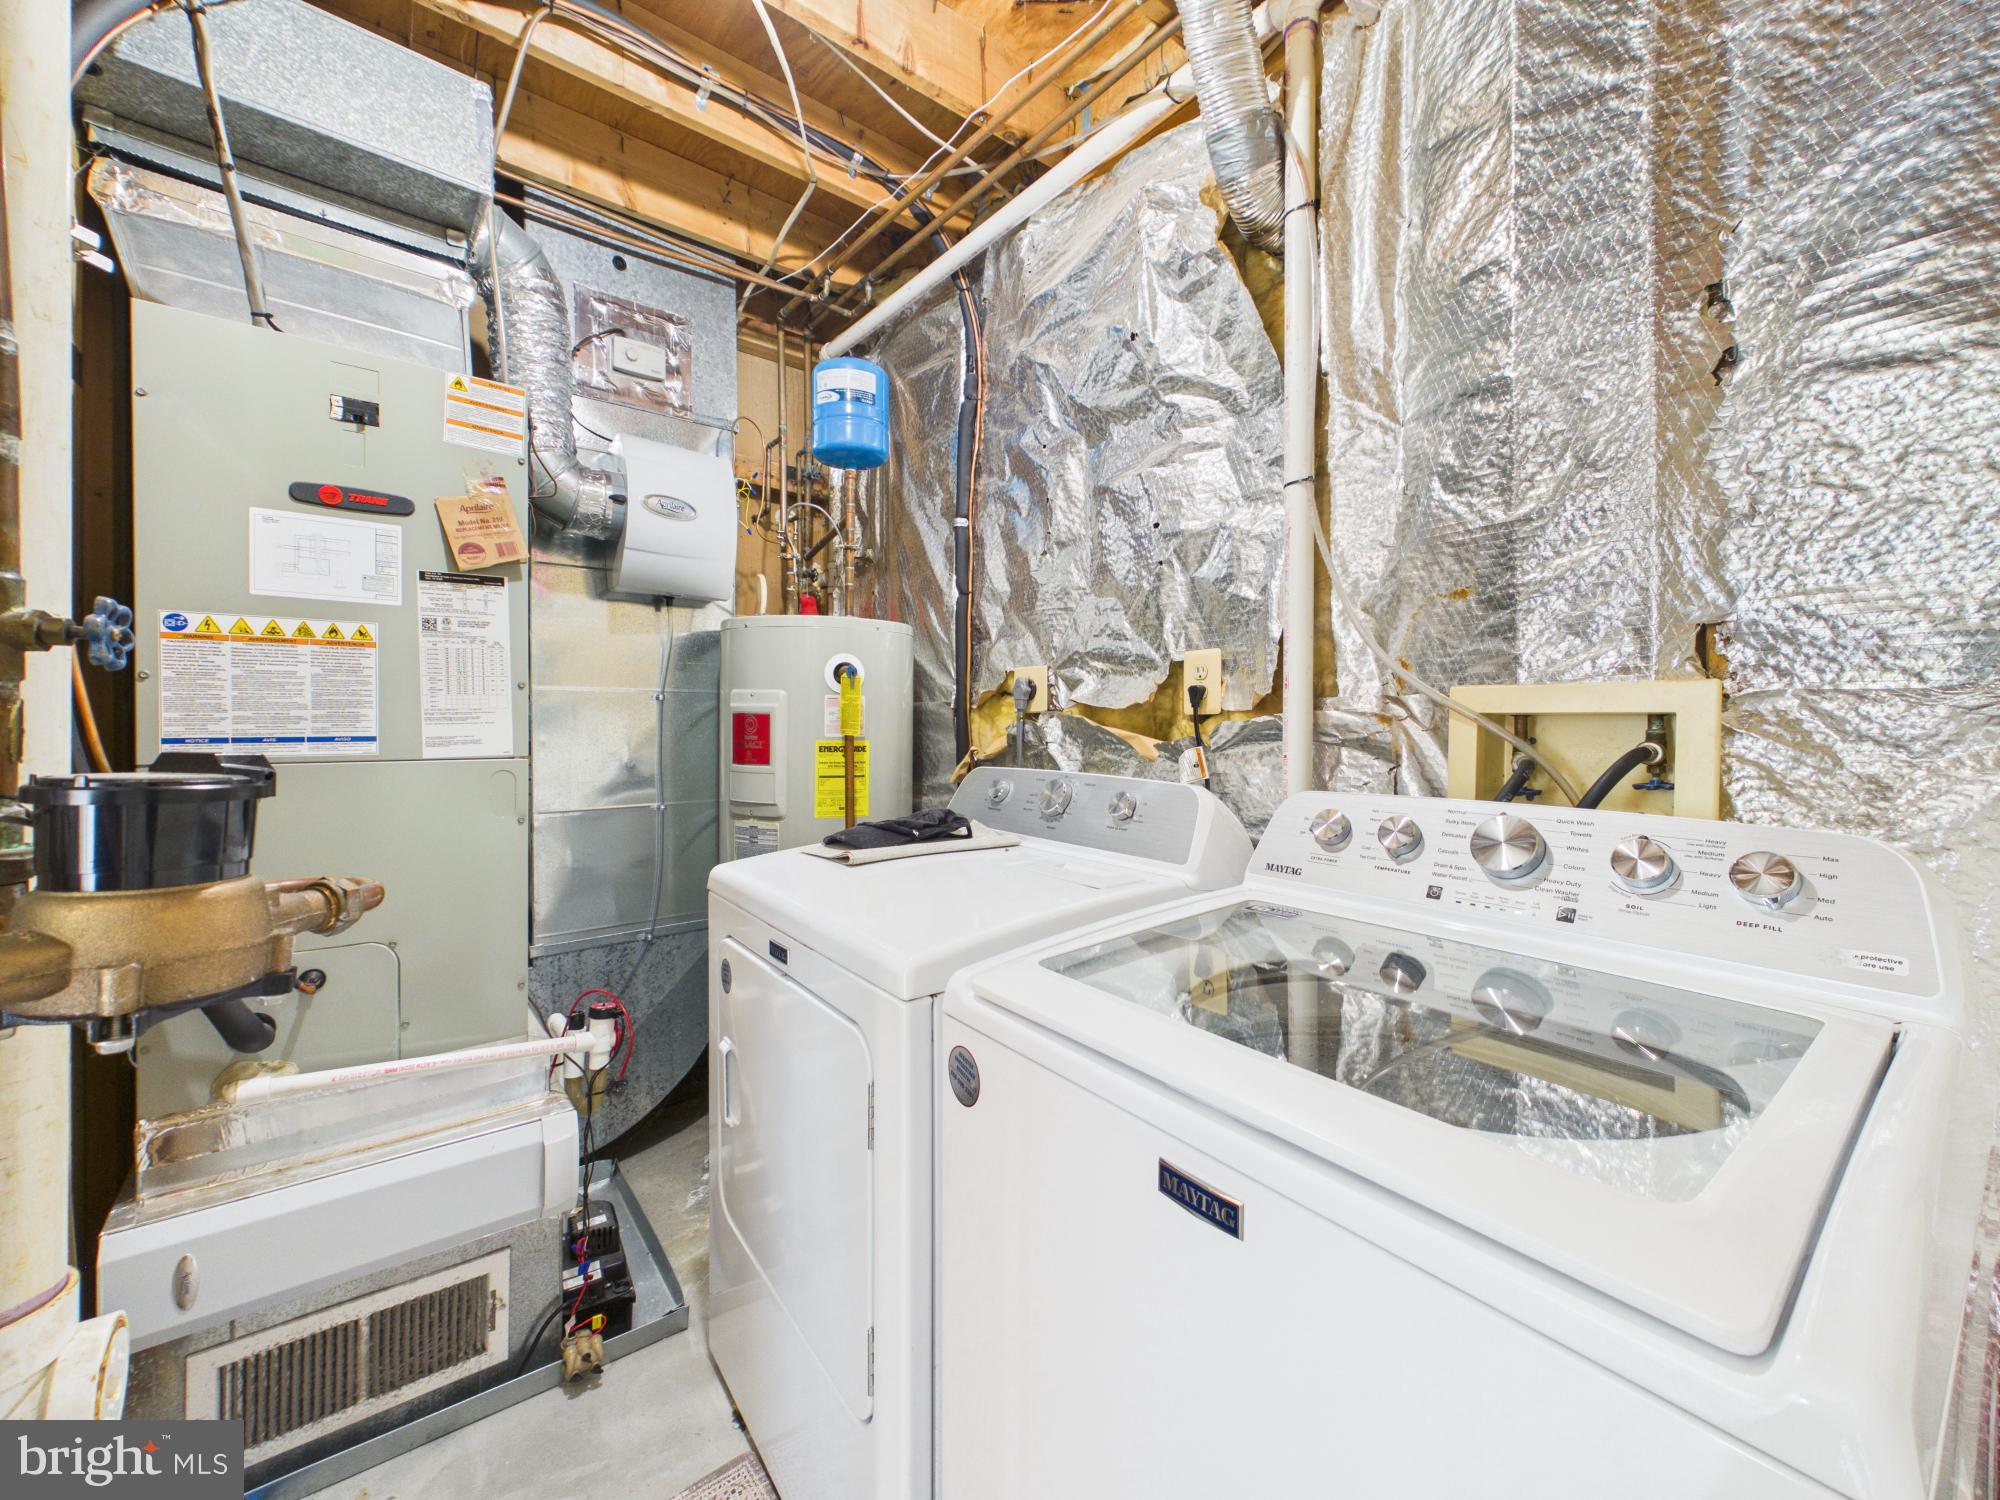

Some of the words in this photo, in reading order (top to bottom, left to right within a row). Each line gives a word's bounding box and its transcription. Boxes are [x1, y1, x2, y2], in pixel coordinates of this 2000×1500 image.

[347, 492, 389, 506] TRANE
[459, 503, 494, 514] Aprilaire
[1576, 819, 1595, 827] Wash
[1566, 845, 1589, 853] Whites
[1265, 863, 1303, 876] MAYTAG
[1374, 865, 1411, 875] TEMPERATURE
[1432, 872, 1448, 880] Water
[1543, 877, 1564, 886] Heavy
[1565, 880, 1582, 888] Duty
[1555, 888, 1580, 897] Washer
[1690, 889, 1719, 898] Medium
[1817, 897, 1836, 905] Med
[1814, 914, 1834, 922] Auto
[1736, 920, 1760, 929] DEEP
[1762, 924, 1783, 933] FILL
[1860, 954, 1904, 965] protective
[1879, 963, 1895, 972] use
[1163, 1171, 1235, 1228] MAYTAG
